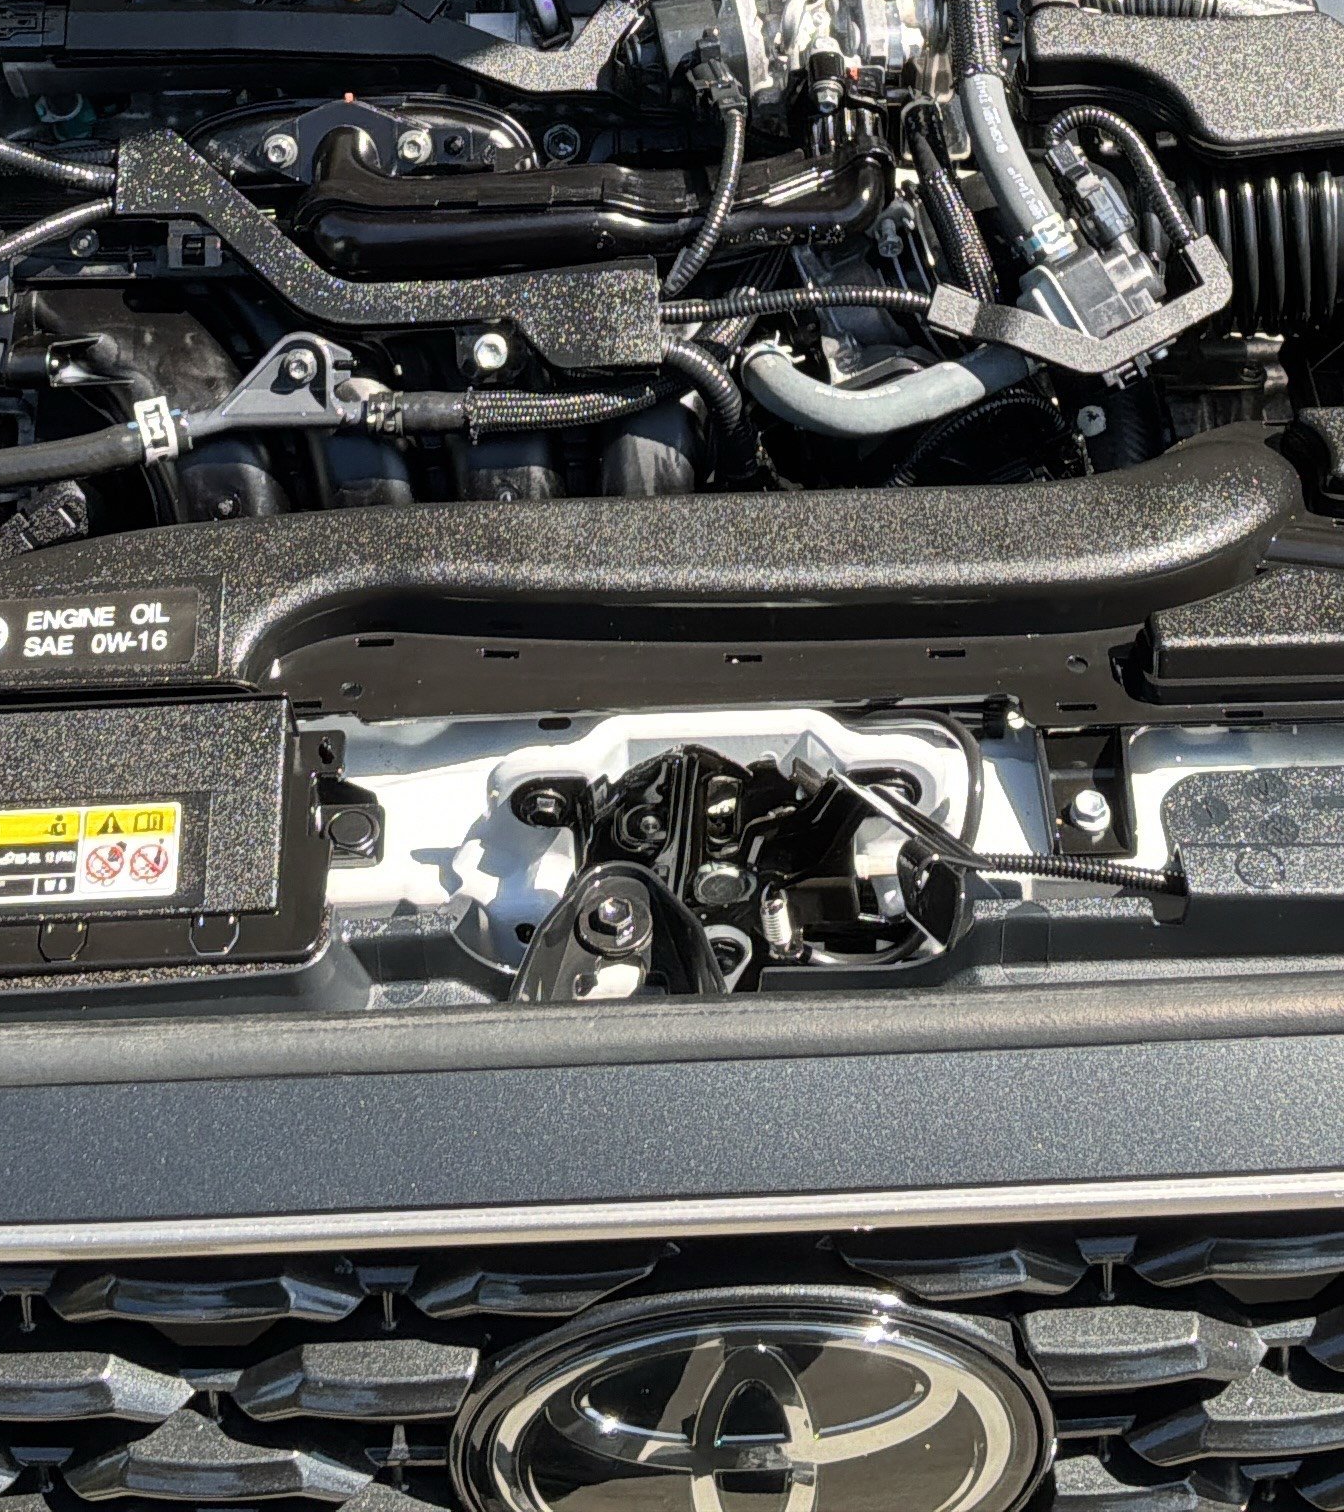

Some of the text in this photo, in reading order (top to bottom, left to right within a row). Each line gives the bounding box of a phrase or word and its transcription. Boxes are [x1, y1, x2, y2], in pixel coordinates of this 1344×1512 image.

[26, 601, 171, 631] ENGINE OIL
[22, 629, 168, 658] SAE 0W-16
